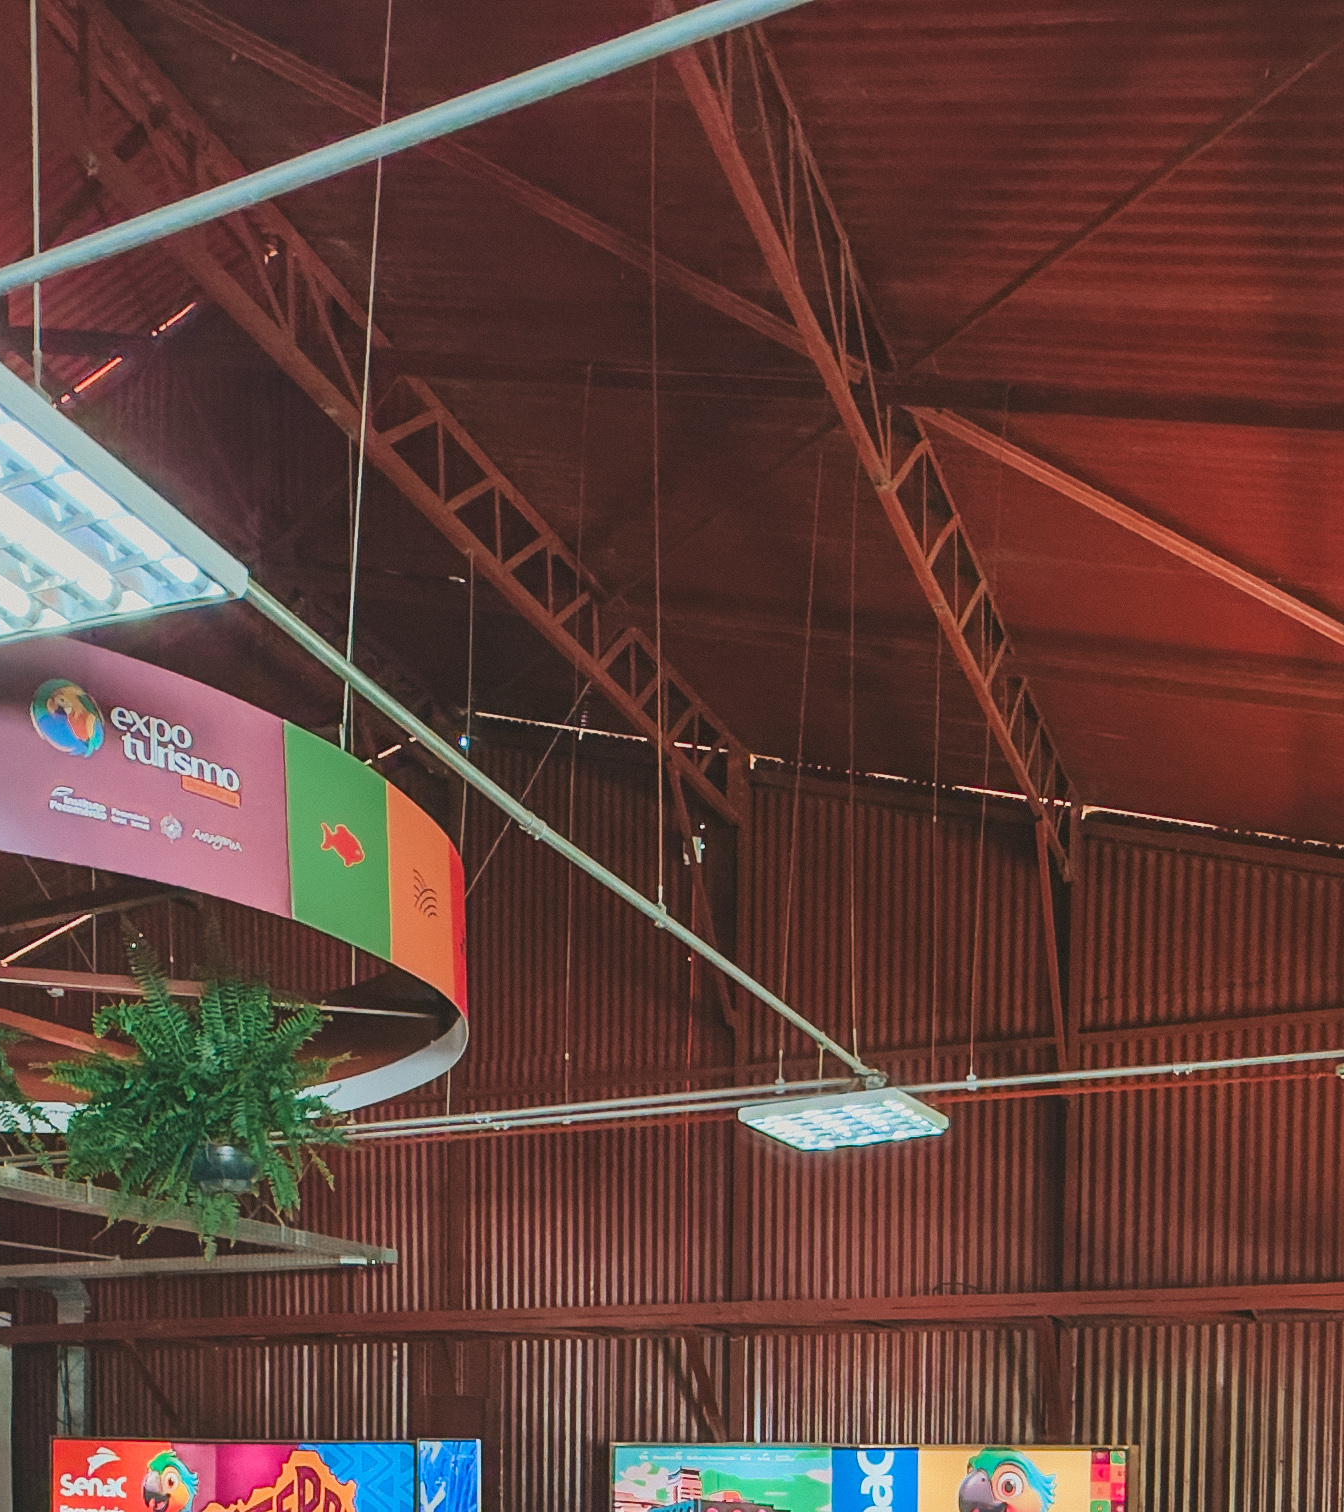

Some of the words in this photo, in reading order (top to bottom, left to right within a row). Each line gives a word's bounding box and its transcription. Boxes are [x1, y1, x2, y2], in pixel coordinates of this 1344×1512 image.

[110, 706, 193, 749] expo
[121, 731, 240, 792] turismo
[59, 1473, 128, 1498] Senac
